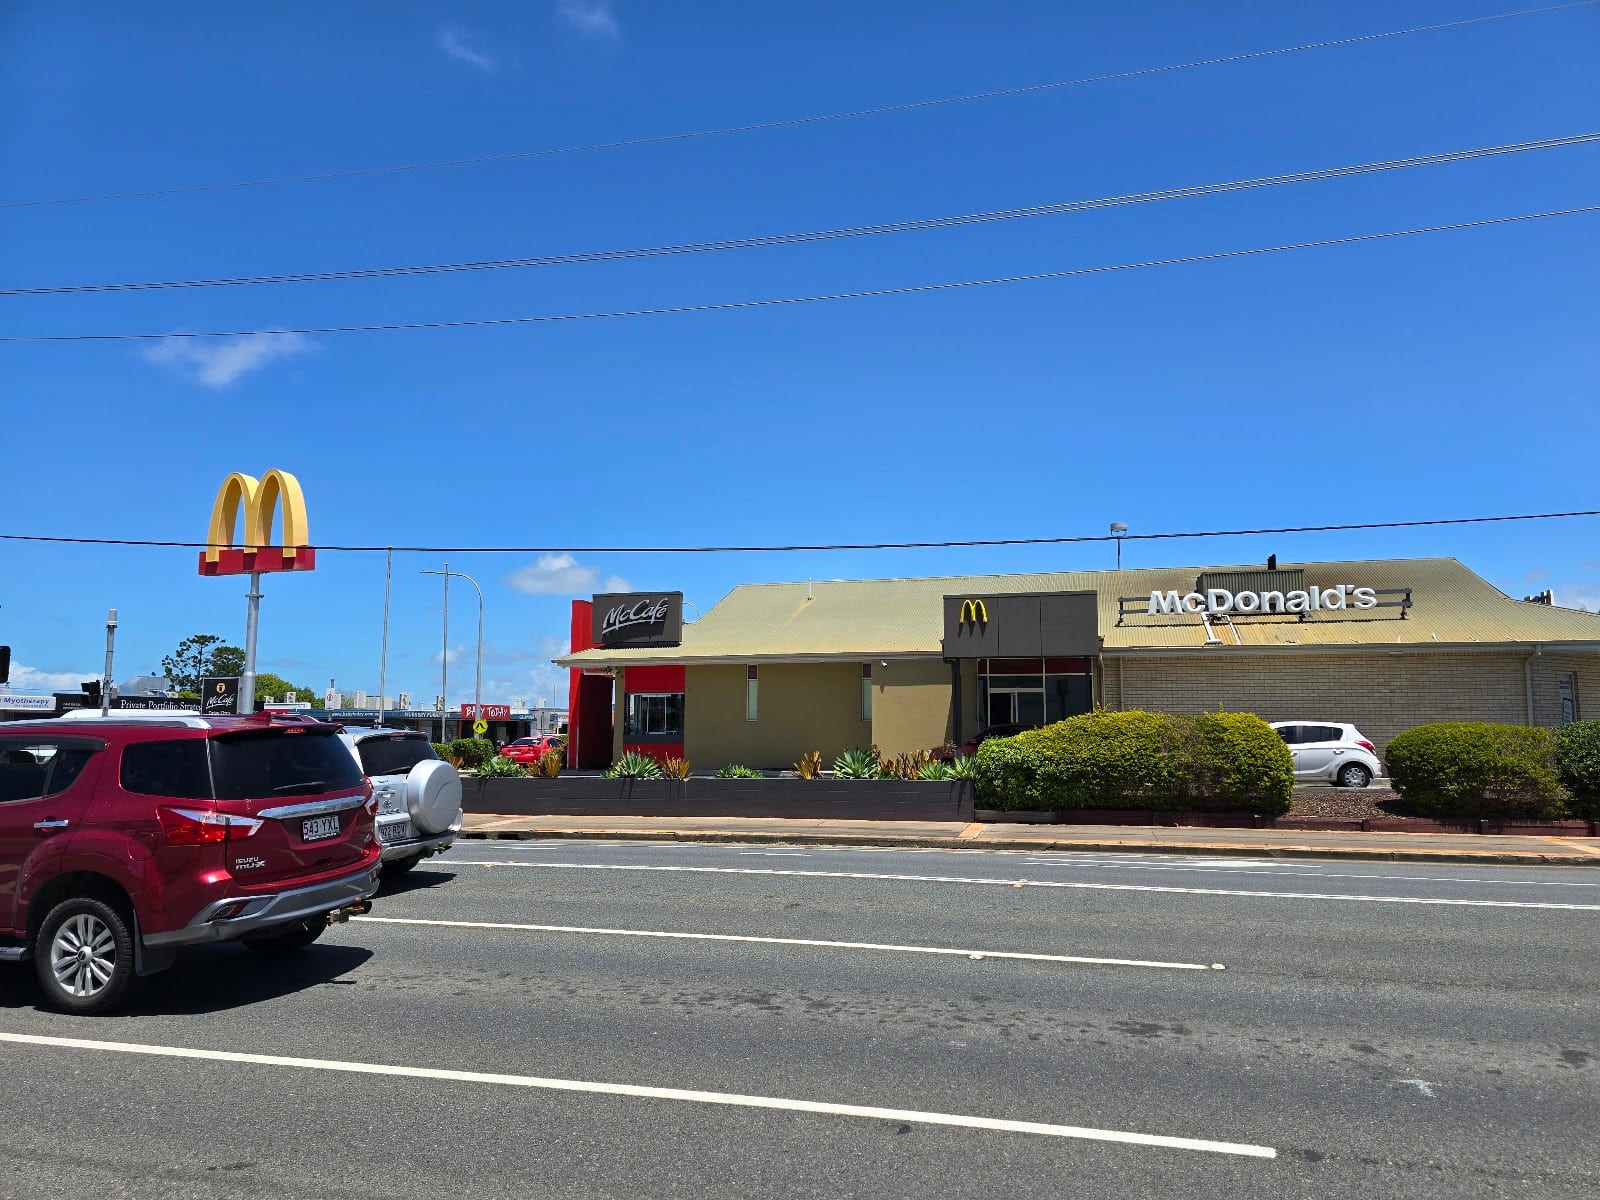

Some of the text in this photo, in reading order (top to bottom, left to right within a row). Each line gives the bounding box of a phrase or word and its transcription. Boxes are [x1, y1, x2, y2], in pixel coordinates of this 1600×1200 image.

[1148, 584, 1378, 615] McDonald's
[602, 597, 669, 633] McCafé
[3, 697, 49, 706] Myotherapy
[120, 699, 146, 709] Private
[148, 700, 179, 710] Portfolio
[303, 816, 339, 836] 543 YXL
[235, 856, 259, 865] ISUZU
